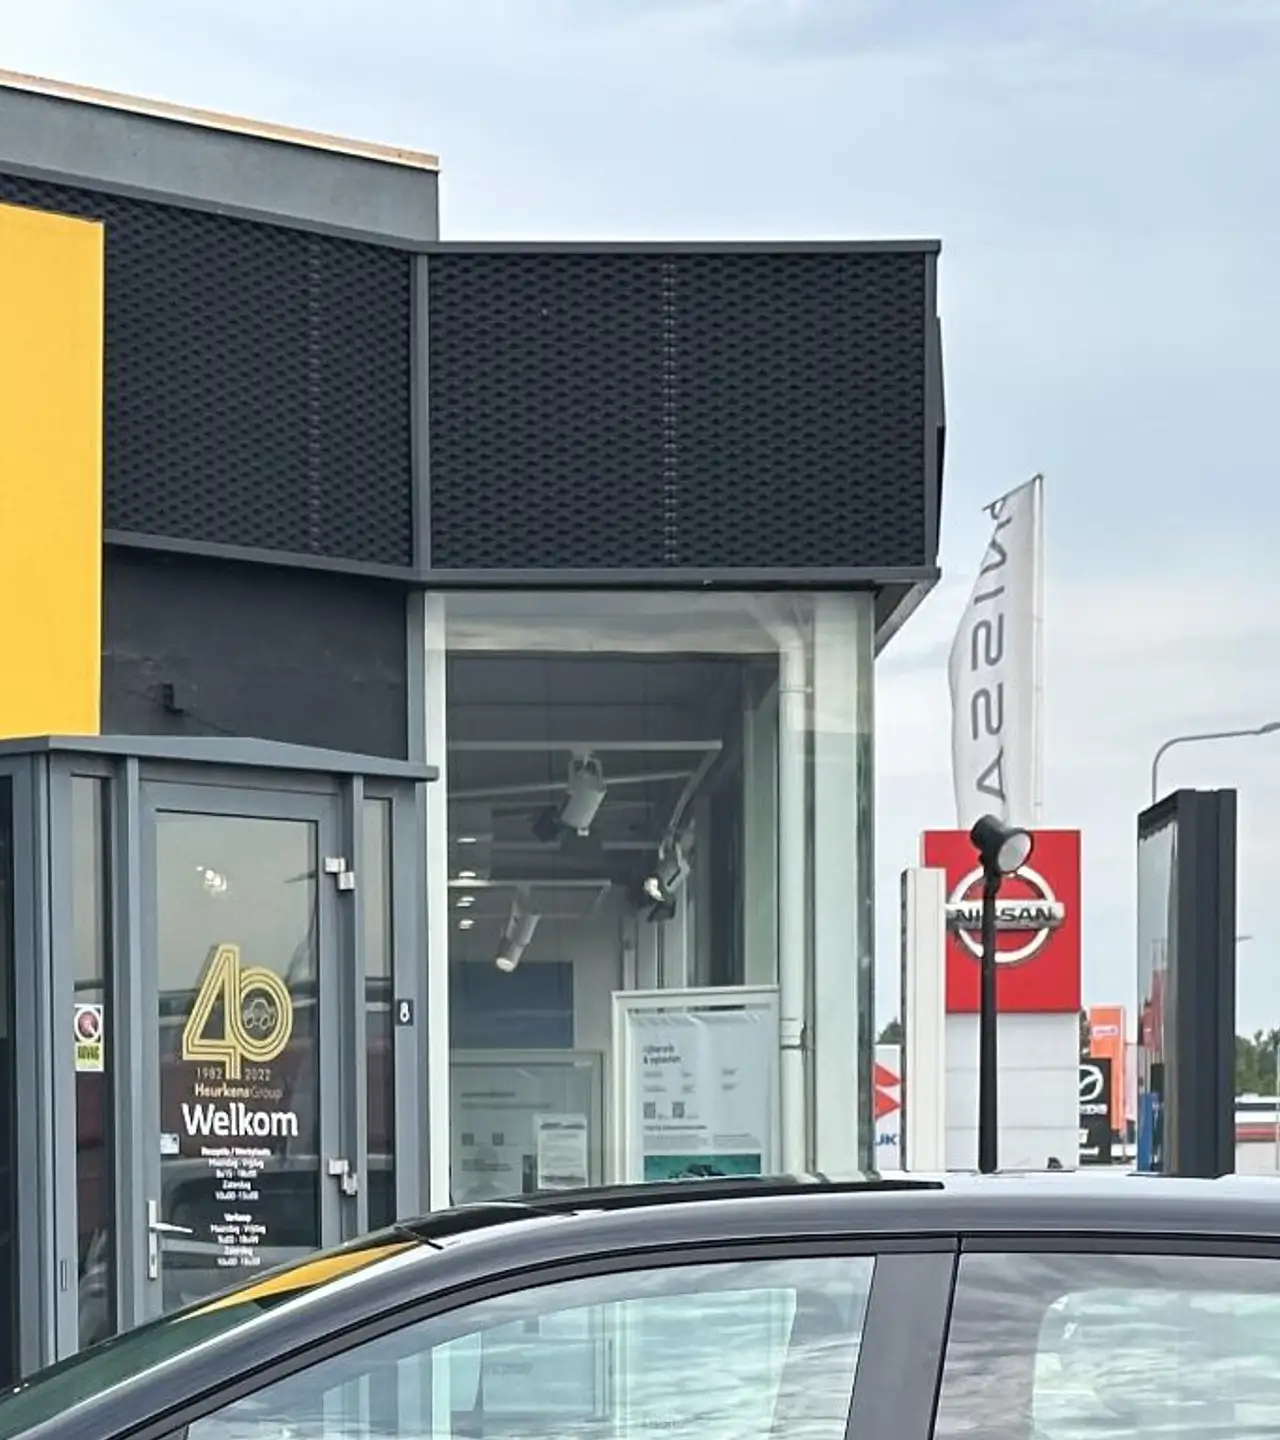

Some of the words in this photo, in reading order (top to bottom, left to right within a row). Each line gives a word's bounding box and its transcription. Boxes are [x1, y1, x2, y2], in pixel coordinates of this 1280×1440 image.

[956, 906, 1054, 923] NISAN
[399, 1001, 411, 1023] 8
[181, 1101, 299, 1137] Welkom
